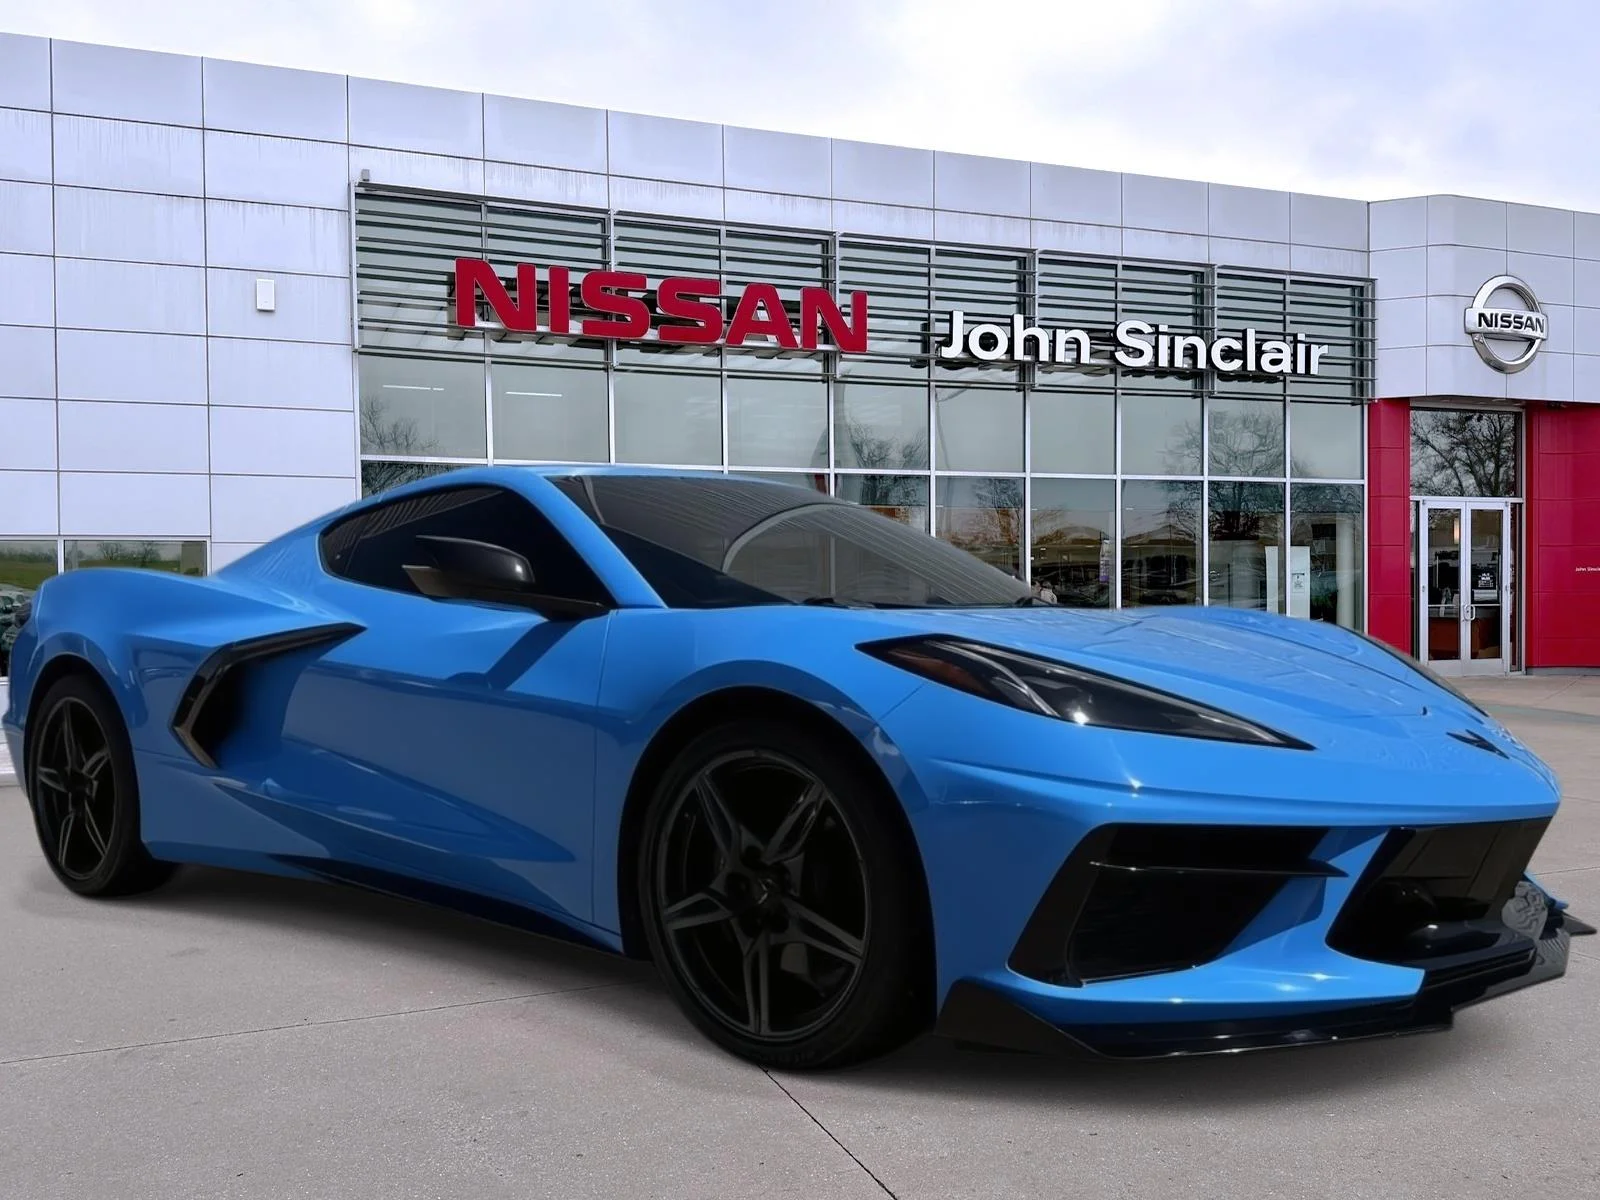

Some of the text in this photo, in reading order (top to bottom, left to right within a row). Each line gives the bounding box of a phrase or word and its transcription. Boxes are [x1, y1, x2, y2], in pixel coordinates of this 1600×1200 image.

[454, 257, 868, 354] NISSAN
[1477, 312, 1544, 333] NISSAN
[940, 310, 1329, 375] John Sinclair
